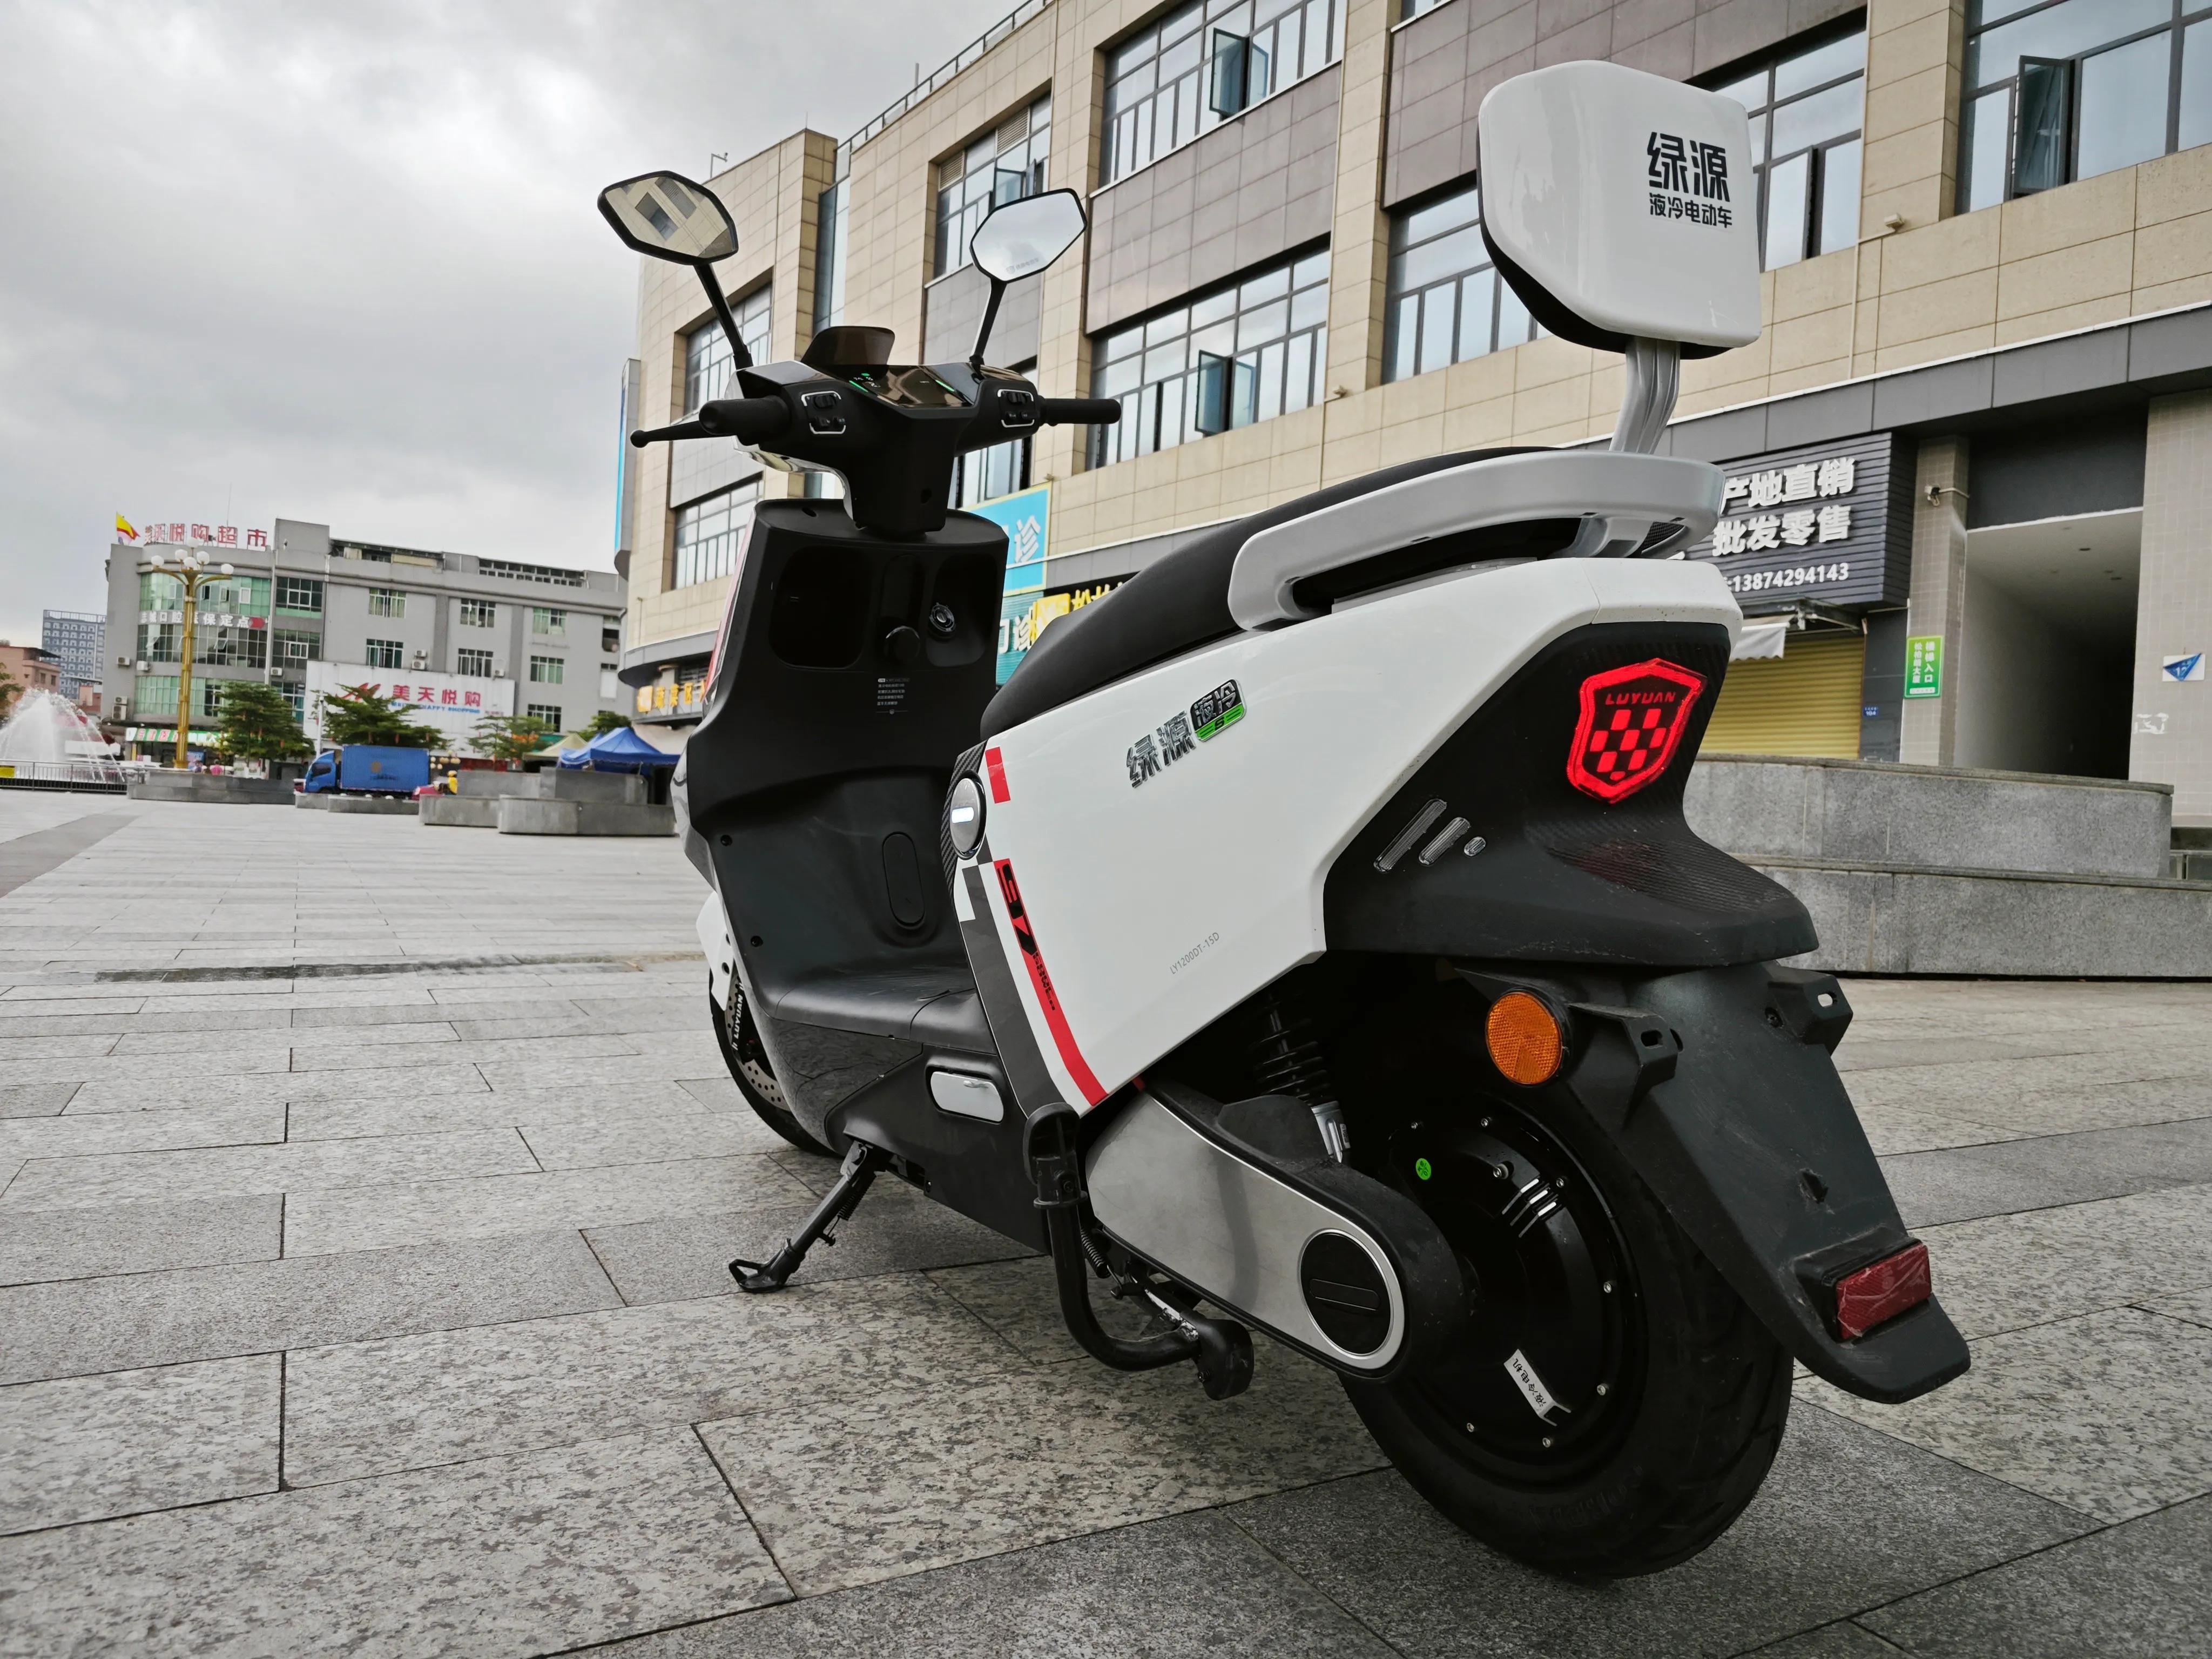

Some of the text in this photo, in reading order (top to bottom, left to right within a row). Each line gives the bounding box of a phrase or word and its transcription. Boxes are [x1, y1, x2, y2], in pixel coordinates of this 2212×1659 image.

[1647, 132, 1730, 203] 绿源
[1649, 192, 1732, 228] 液冷电动车
[1719, 457, 1856, 514] 产地直销
[1712, 504, 1851, 557] 批发零售
[393, 684, 481, 707] 美天悦购
[1193, 682, 1236, 727] 液冷
[1605, 691, 1676, 705] LUYUAN
[1126, 709, 1197, 788] 绿源
[1169, 932, 1220, 975] LY1200DT-15D
[733, 994, 743, 1040] LUYUAN
[1513, 1358, 1547, 1407] 液冷电机
